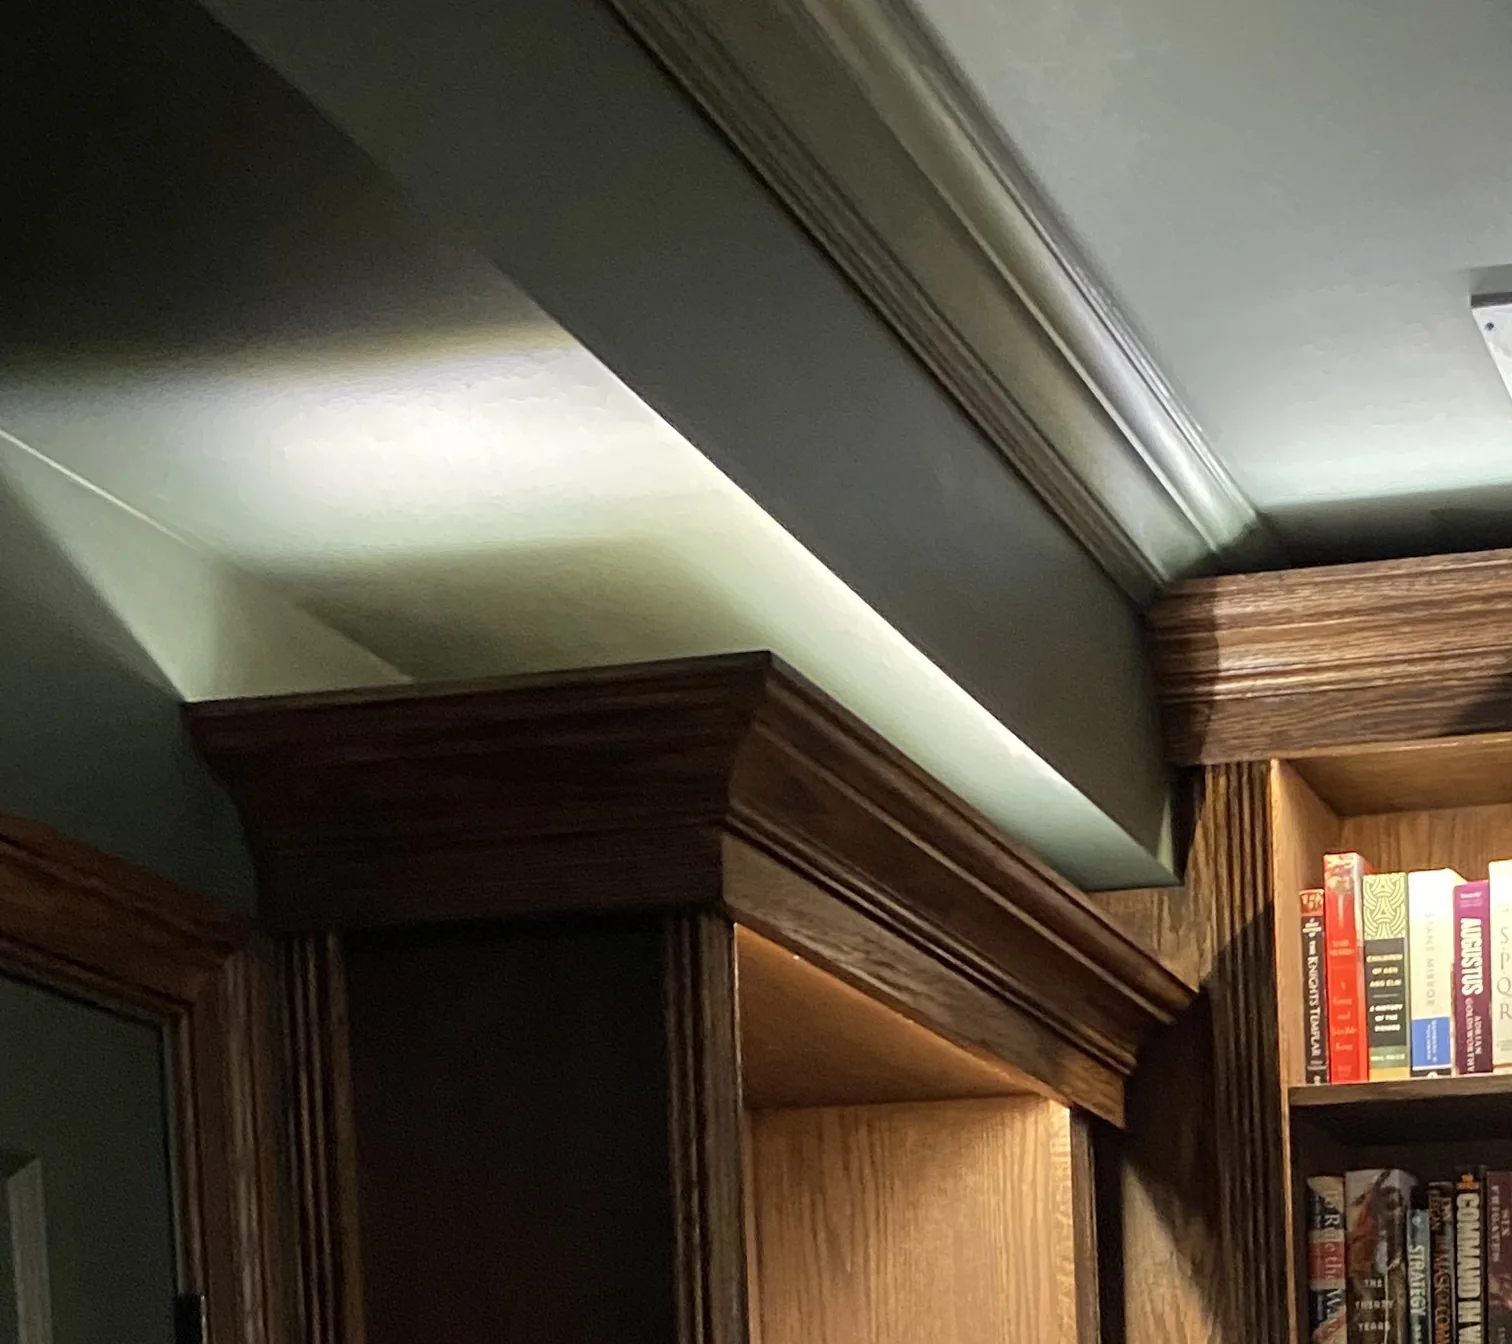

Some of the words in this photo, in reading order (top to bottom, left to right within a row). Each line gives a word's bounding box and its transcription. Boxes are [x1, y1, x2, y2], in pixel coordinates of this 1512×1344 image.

[1308, 956, 1321, 1006] KNIGHTS
[1461, 917, 1483, 998] AUGUSTUS
[1310, 1007, 1322, 1057] TEMPLAR
[1465, 997, 1475, 1073] GOLDSWORTHY
[1474, 1014, 1483, 1055] ADRIAN
[1456, 1193, 1481, 1298] COMMAND
[1410, 1244, 1427, 1316] STRATEGY
[1435, 1252, 1451, 1292] MASK
[1456, 1300, 1481, 1323] IN
